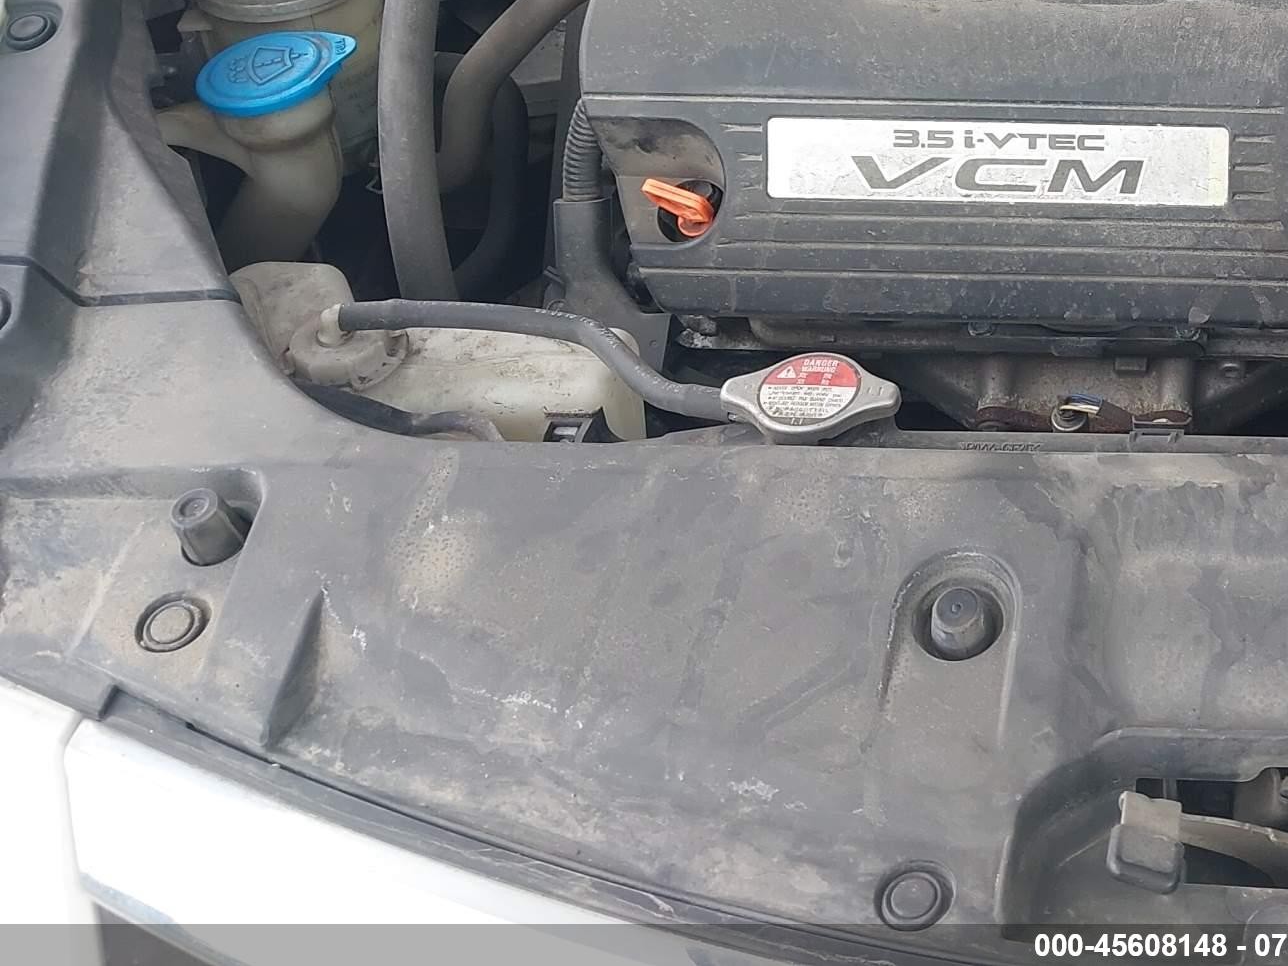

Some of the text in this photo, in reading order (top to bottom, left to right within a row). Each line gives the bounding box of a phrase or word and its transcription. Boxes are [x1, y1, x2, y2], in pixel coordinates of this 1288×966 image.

[893, 129, 1105, 151] 3.5 i-VTEC
[851, 155, 1145, 194] VCM
[804, 359, 839, 367] DANGER
